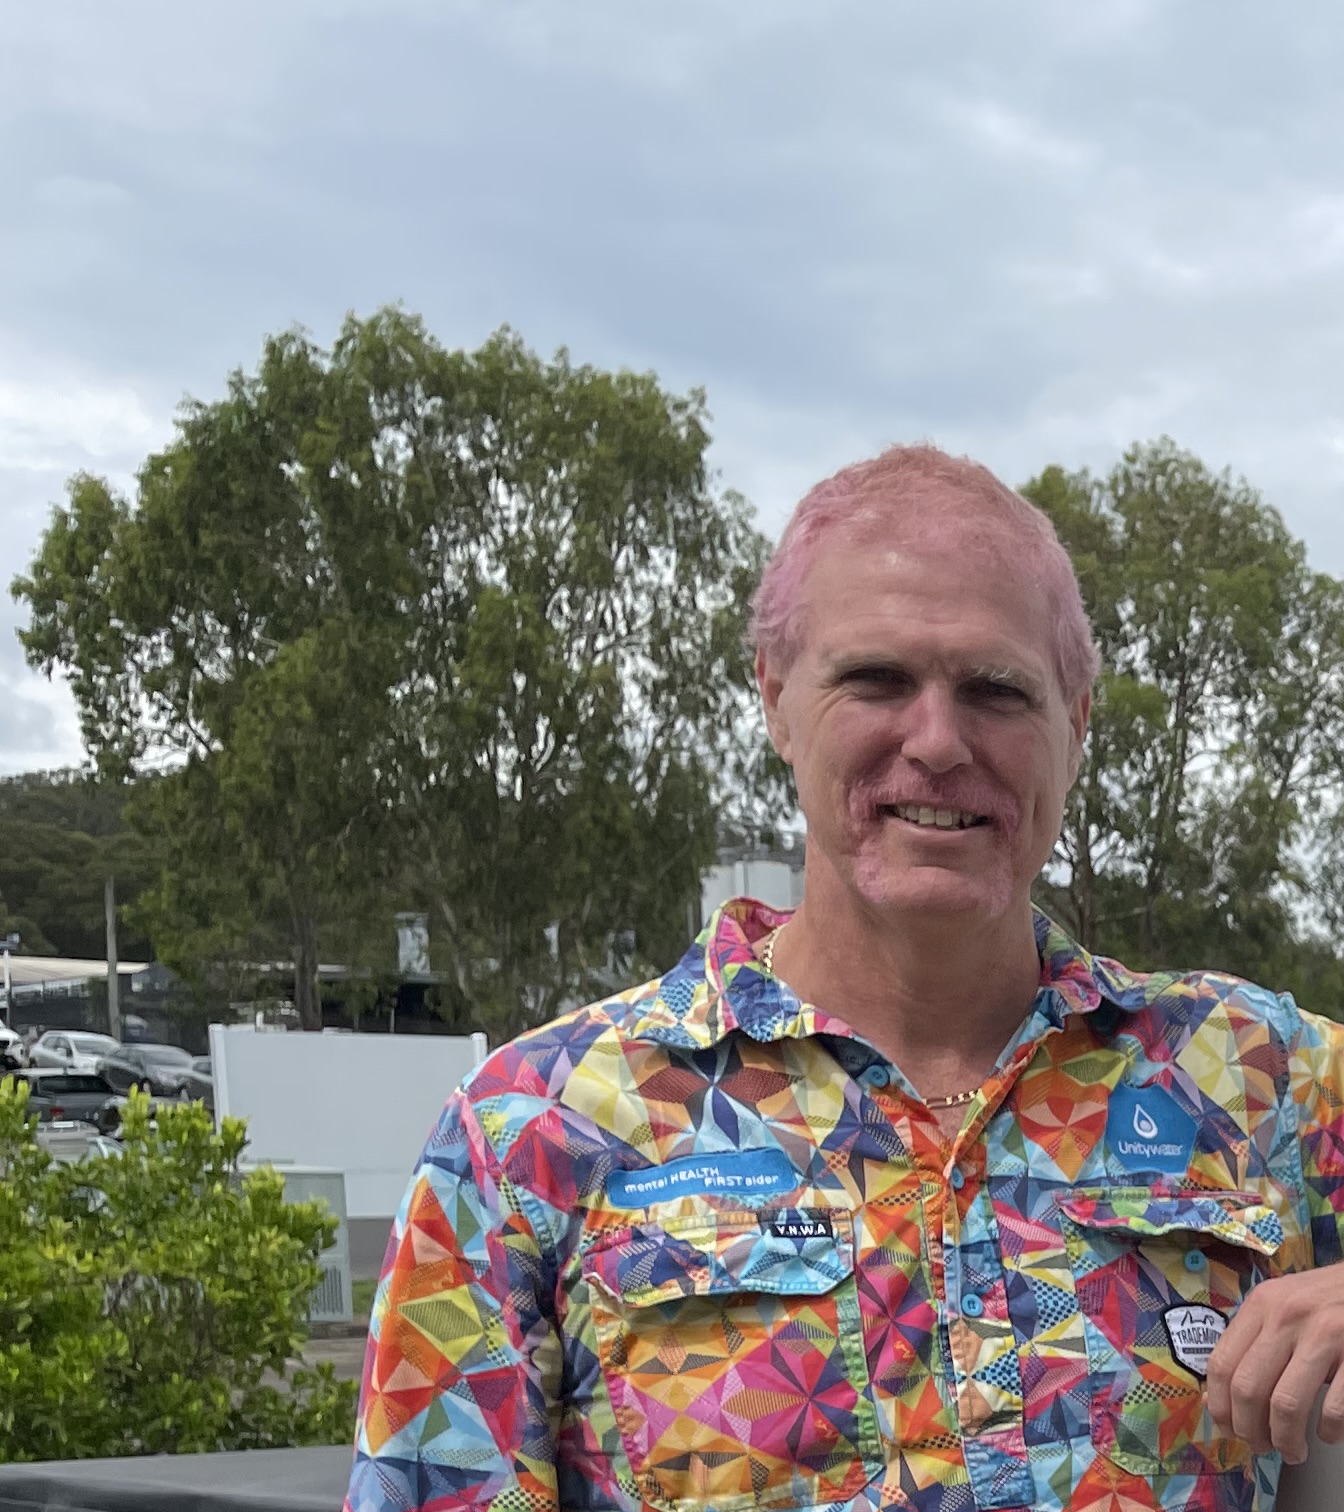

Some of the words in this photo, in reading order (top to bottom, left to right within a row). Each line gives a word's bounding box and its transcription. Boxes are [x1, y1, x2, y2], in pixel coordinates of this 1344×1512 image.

[1117, 1140, 1183, 1158] Unitywater
[624, 1178, 667, 1194] mental
[671, 1167, 719, 1184] HEALTH
[704, 1176, 742, 1188] FIRST
[745, 1175, 779, 1187] aider
